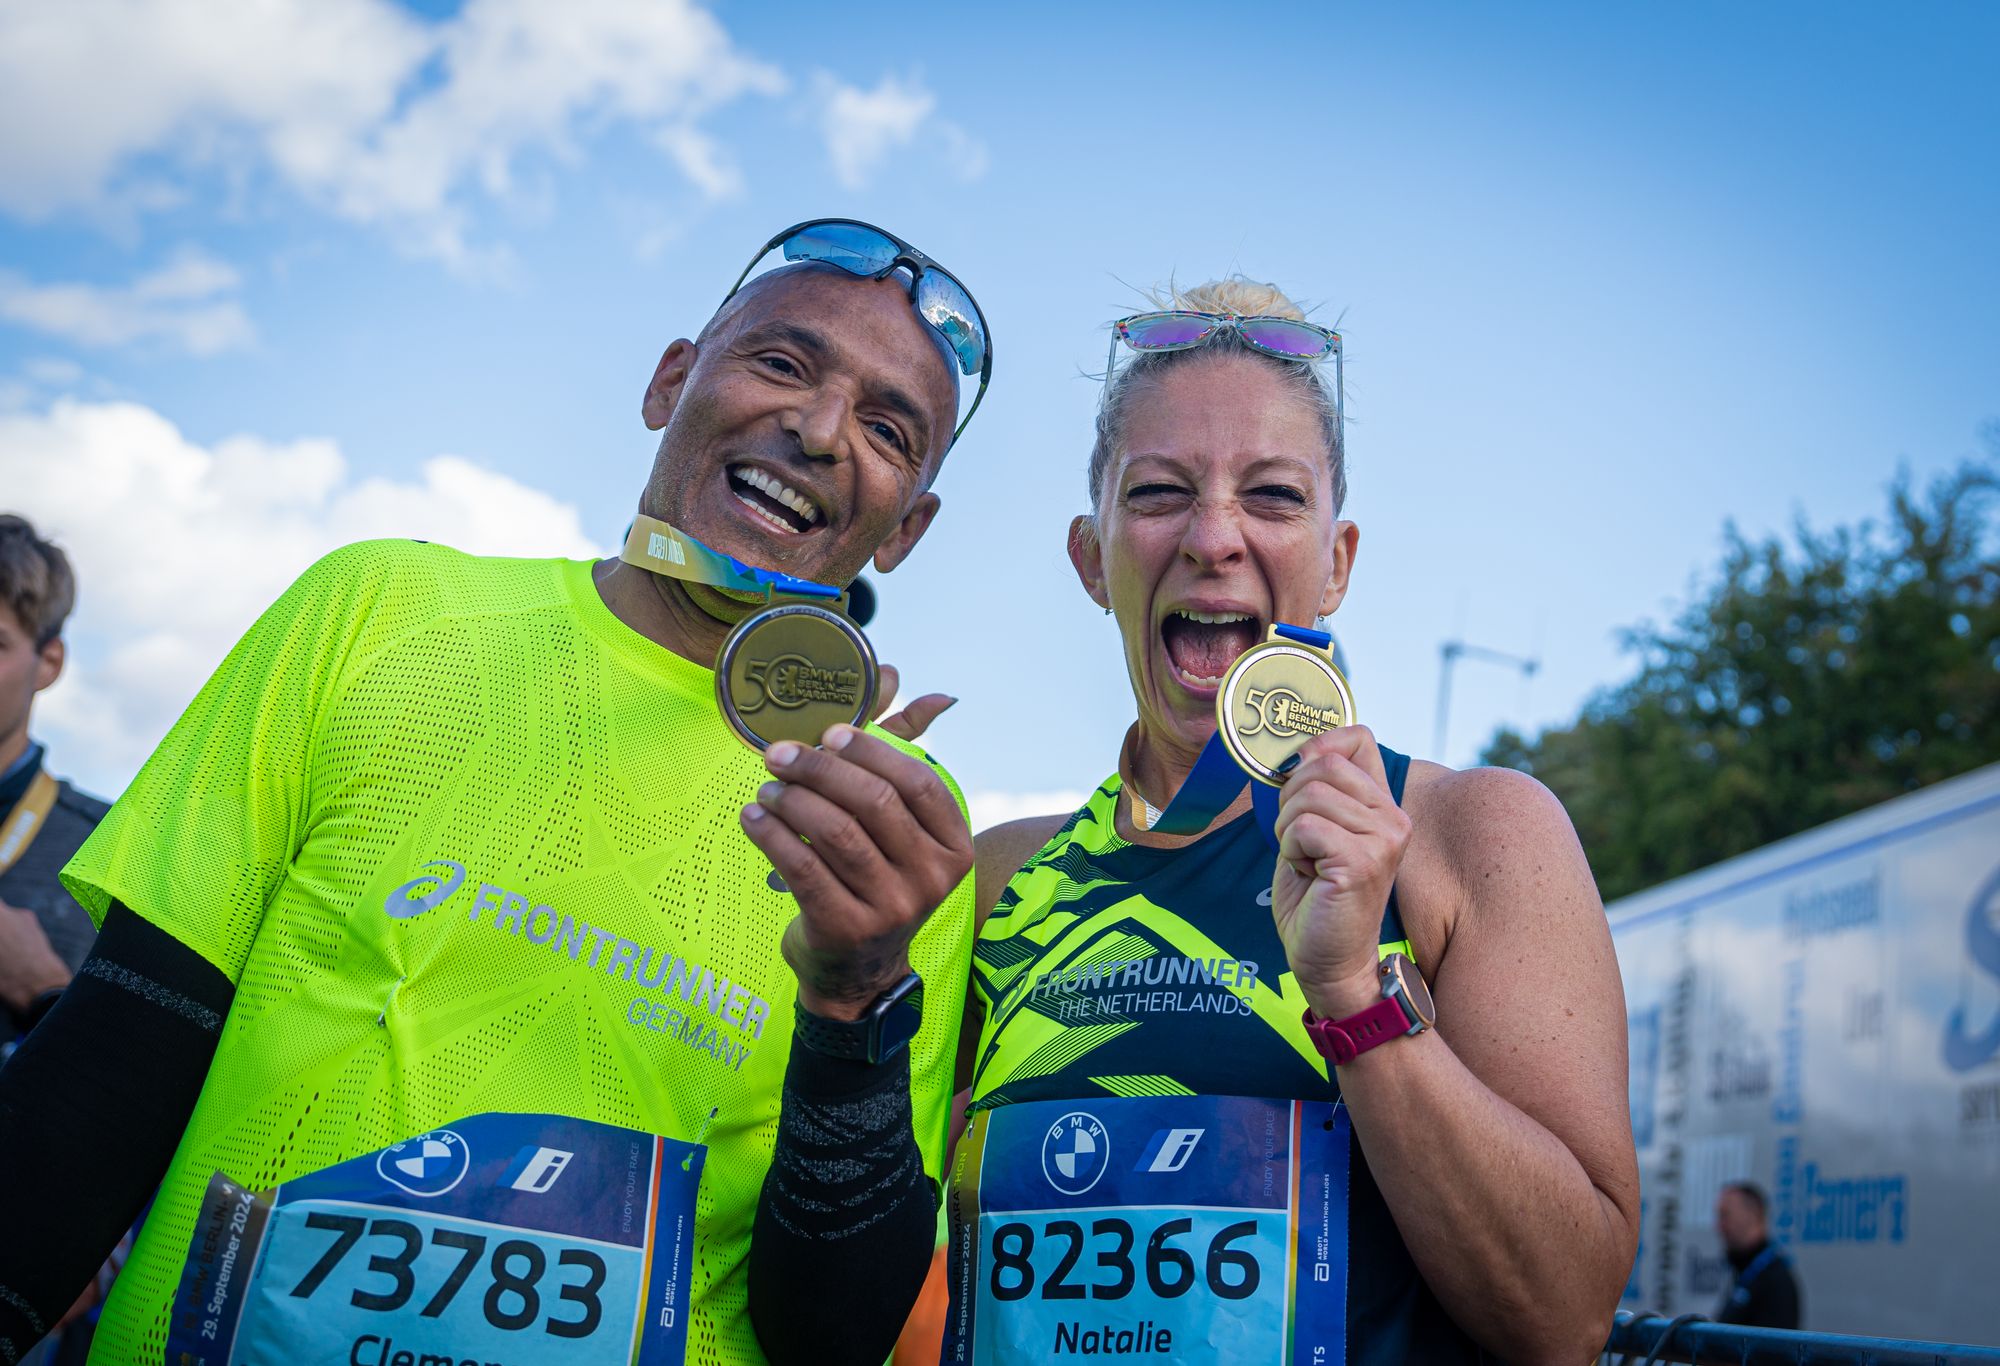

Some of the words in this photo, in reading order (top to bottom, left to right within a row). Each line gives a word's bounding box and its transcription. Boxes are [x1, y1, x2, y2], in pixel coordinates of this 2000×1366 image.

[739, 654, 813, 711] 50
[798, 679, 835, 690] BERLIN
[800, 667, 836, 682] BMW
[796, 688, 855, 703] MARATHON
[1290, 701, 1322, 719] BMW
[1238, 688, 1302, 737] 50
[1288, 712, 1320, 727] BERLIN
[1287, 721, 1325, 736] MARATH
[468, 882, 771, 1040] FRONTRUNNER
[1031, 957, 1260, 1002] FRONTRUNNER
[1059, 1000, 1091, 1020] THE
[1096, 991, 1254, 1017] NETHERLANDS
[627, 998, 752, 1072] GERMANY
[1052, 1116, 1102, 1138] BMW
[1266, 1110, 1275, 1135] RACE
[630, 1142, 640, 1170] RACE
[1265, 1138, 1274, 1164] YOUR
[626, 1171, 636, 1202] YOUR
[1263, 1165, 1274, 1197] ENJOY
[231, 1192, 256, 1235] 2024
[622, 1201, 633, 1233] ENJOY
[676, 1214, 684, 1241] MAJORS
[962, 1223, 971, 1260] 2024
[672, 1243, 681, 1280] MARATHON
[991, 1217, 1261, 1300] 82366
[208, 1234, 241, 1316] September
[289, 1210, 607, 1339] 73783
[958, 1260, 970, 1336] September
[201, 1317, 219, 1341] 29.
[1053, 1320, 1173, 1355] Natalie
[956, 1338, 965, 1362] 29.
